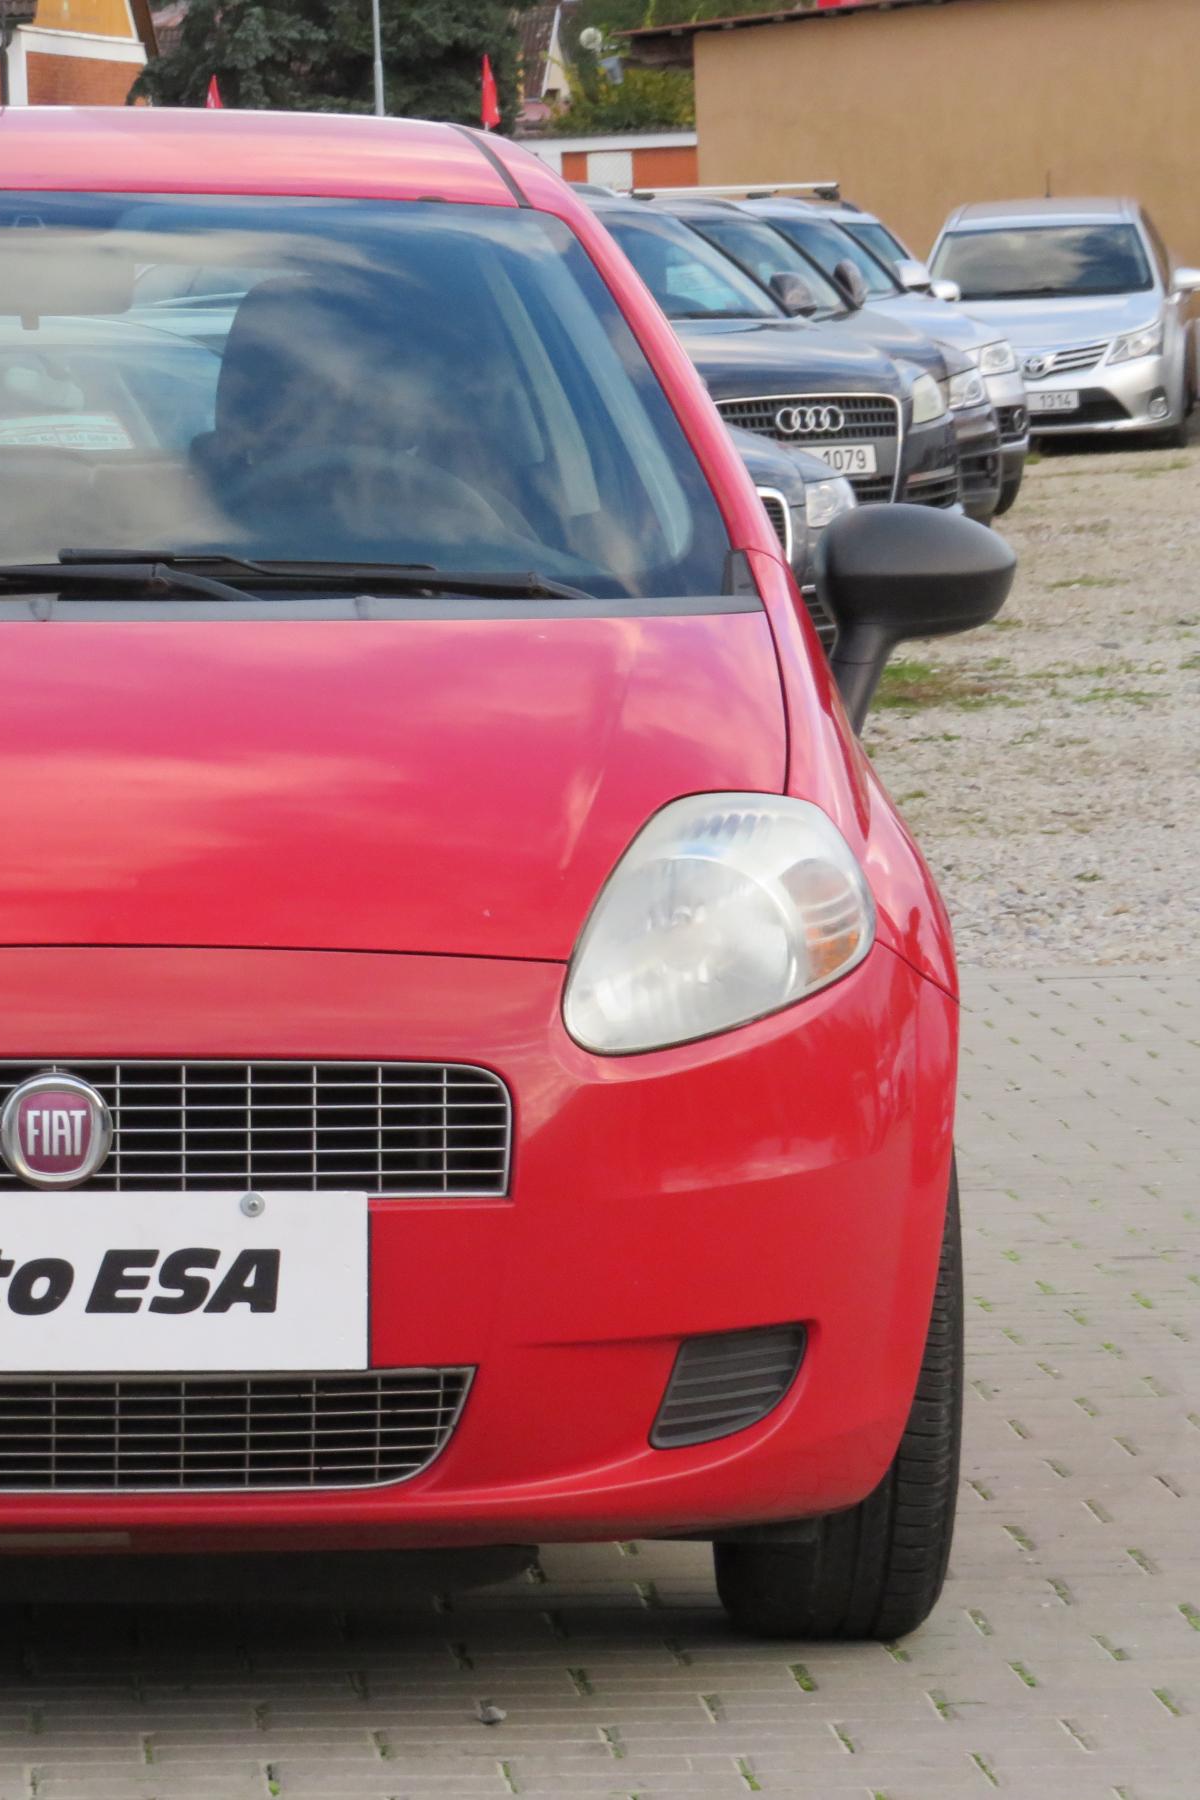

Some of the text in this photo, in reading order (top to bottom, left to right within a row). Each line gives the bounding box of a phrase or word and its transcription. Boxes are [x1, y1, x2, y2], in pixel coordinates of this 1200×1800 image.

[822, 448, 867, 471] 1079
[27, 1109, 87, 1157] FIAT
[84, 1247, 281, 1315] ESA
